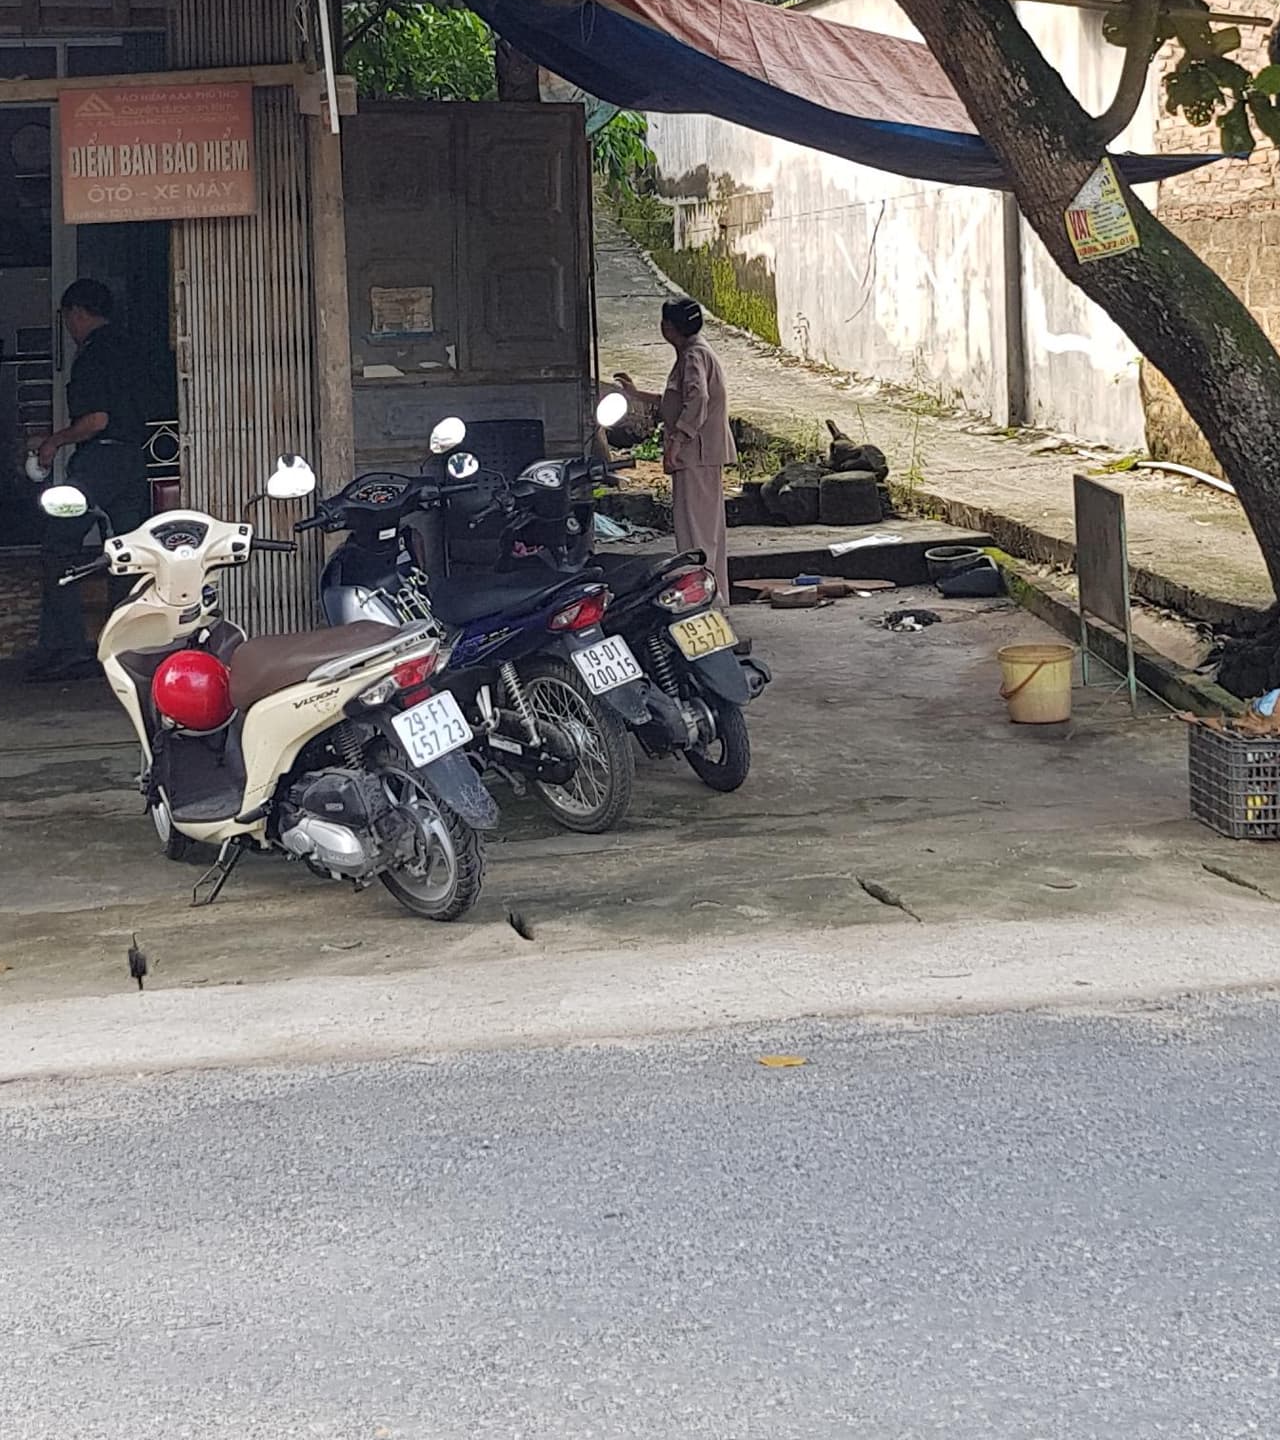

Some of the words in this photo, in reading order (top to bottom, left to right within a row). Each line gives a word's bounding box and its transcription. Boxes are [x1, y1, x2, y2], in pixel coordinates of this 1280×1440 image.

[69, 132, 115, 177] ĐIỂM
[119, 136, 157, 176] BÁN
[162, 128, 198, 174] BẢO
[203, 127, 249, 172] HIỂM
[153, 184, 179, 200] XE
[292, 686, 341, 710] VISION
